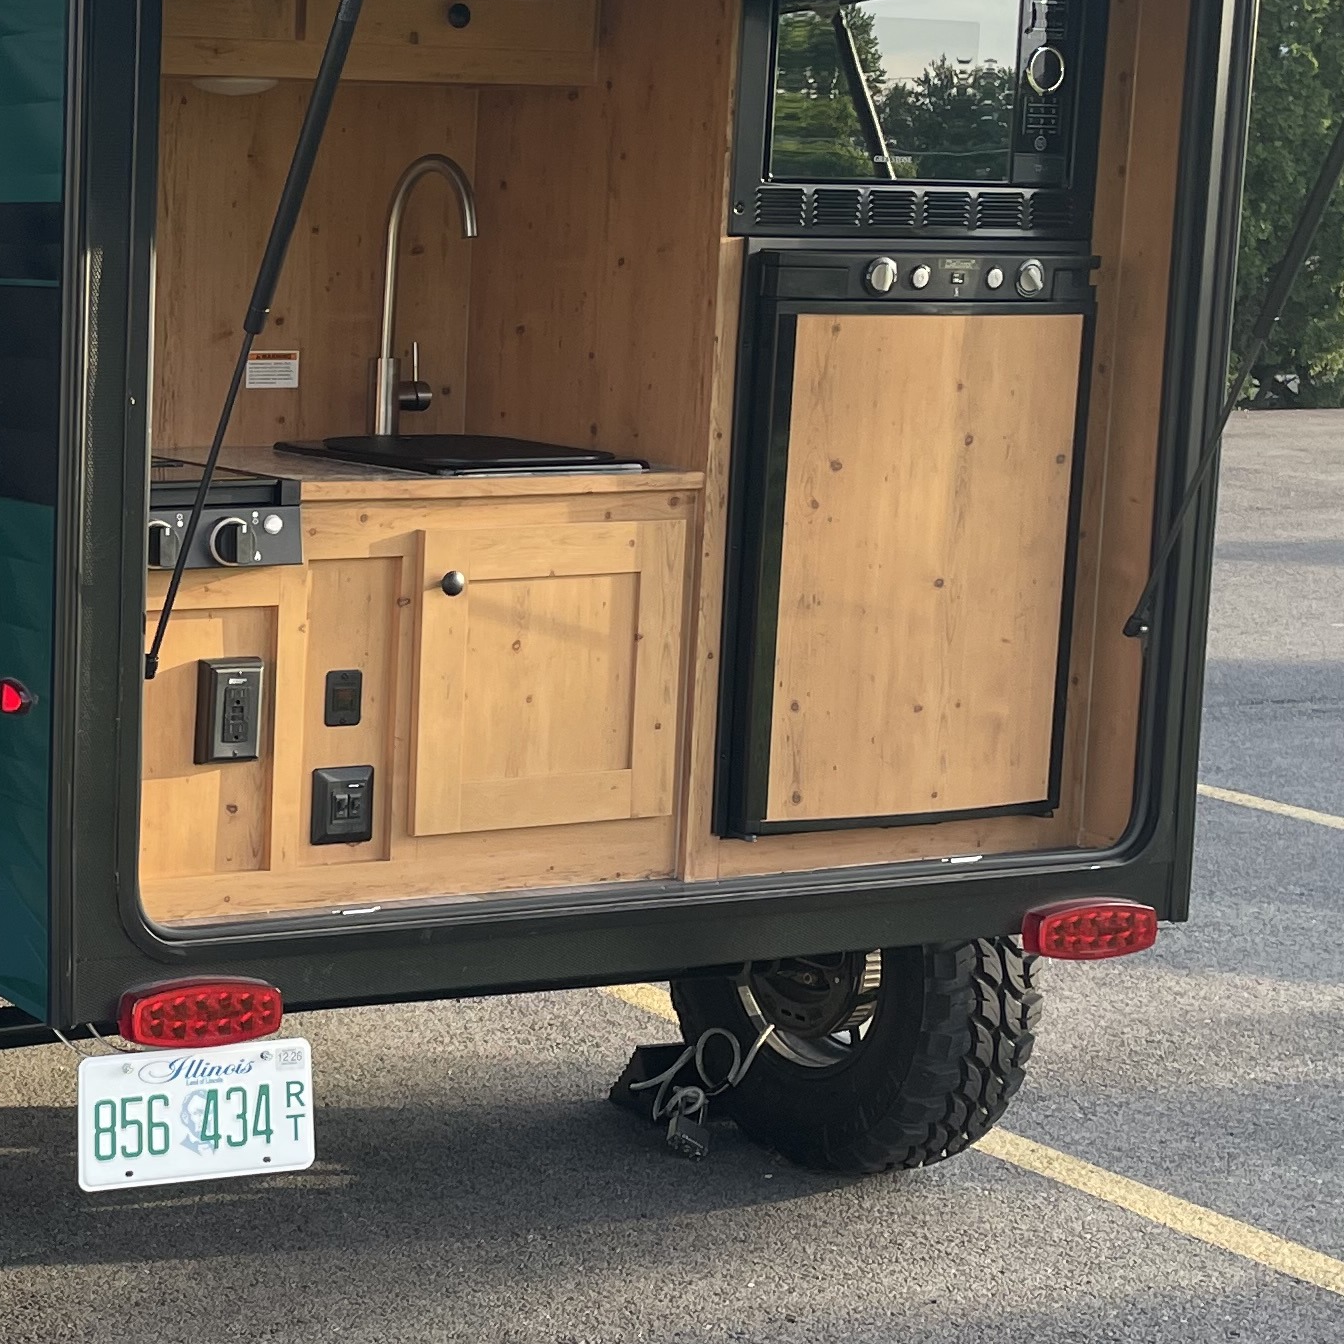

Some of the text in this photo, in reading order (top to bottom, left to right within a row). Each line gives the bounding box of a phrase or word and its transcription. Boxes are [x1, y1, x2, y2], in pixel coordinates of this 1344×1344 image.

[138, 1055, 255, 1085] Illinois
[94, 1083, 274, 1161] 856 434
